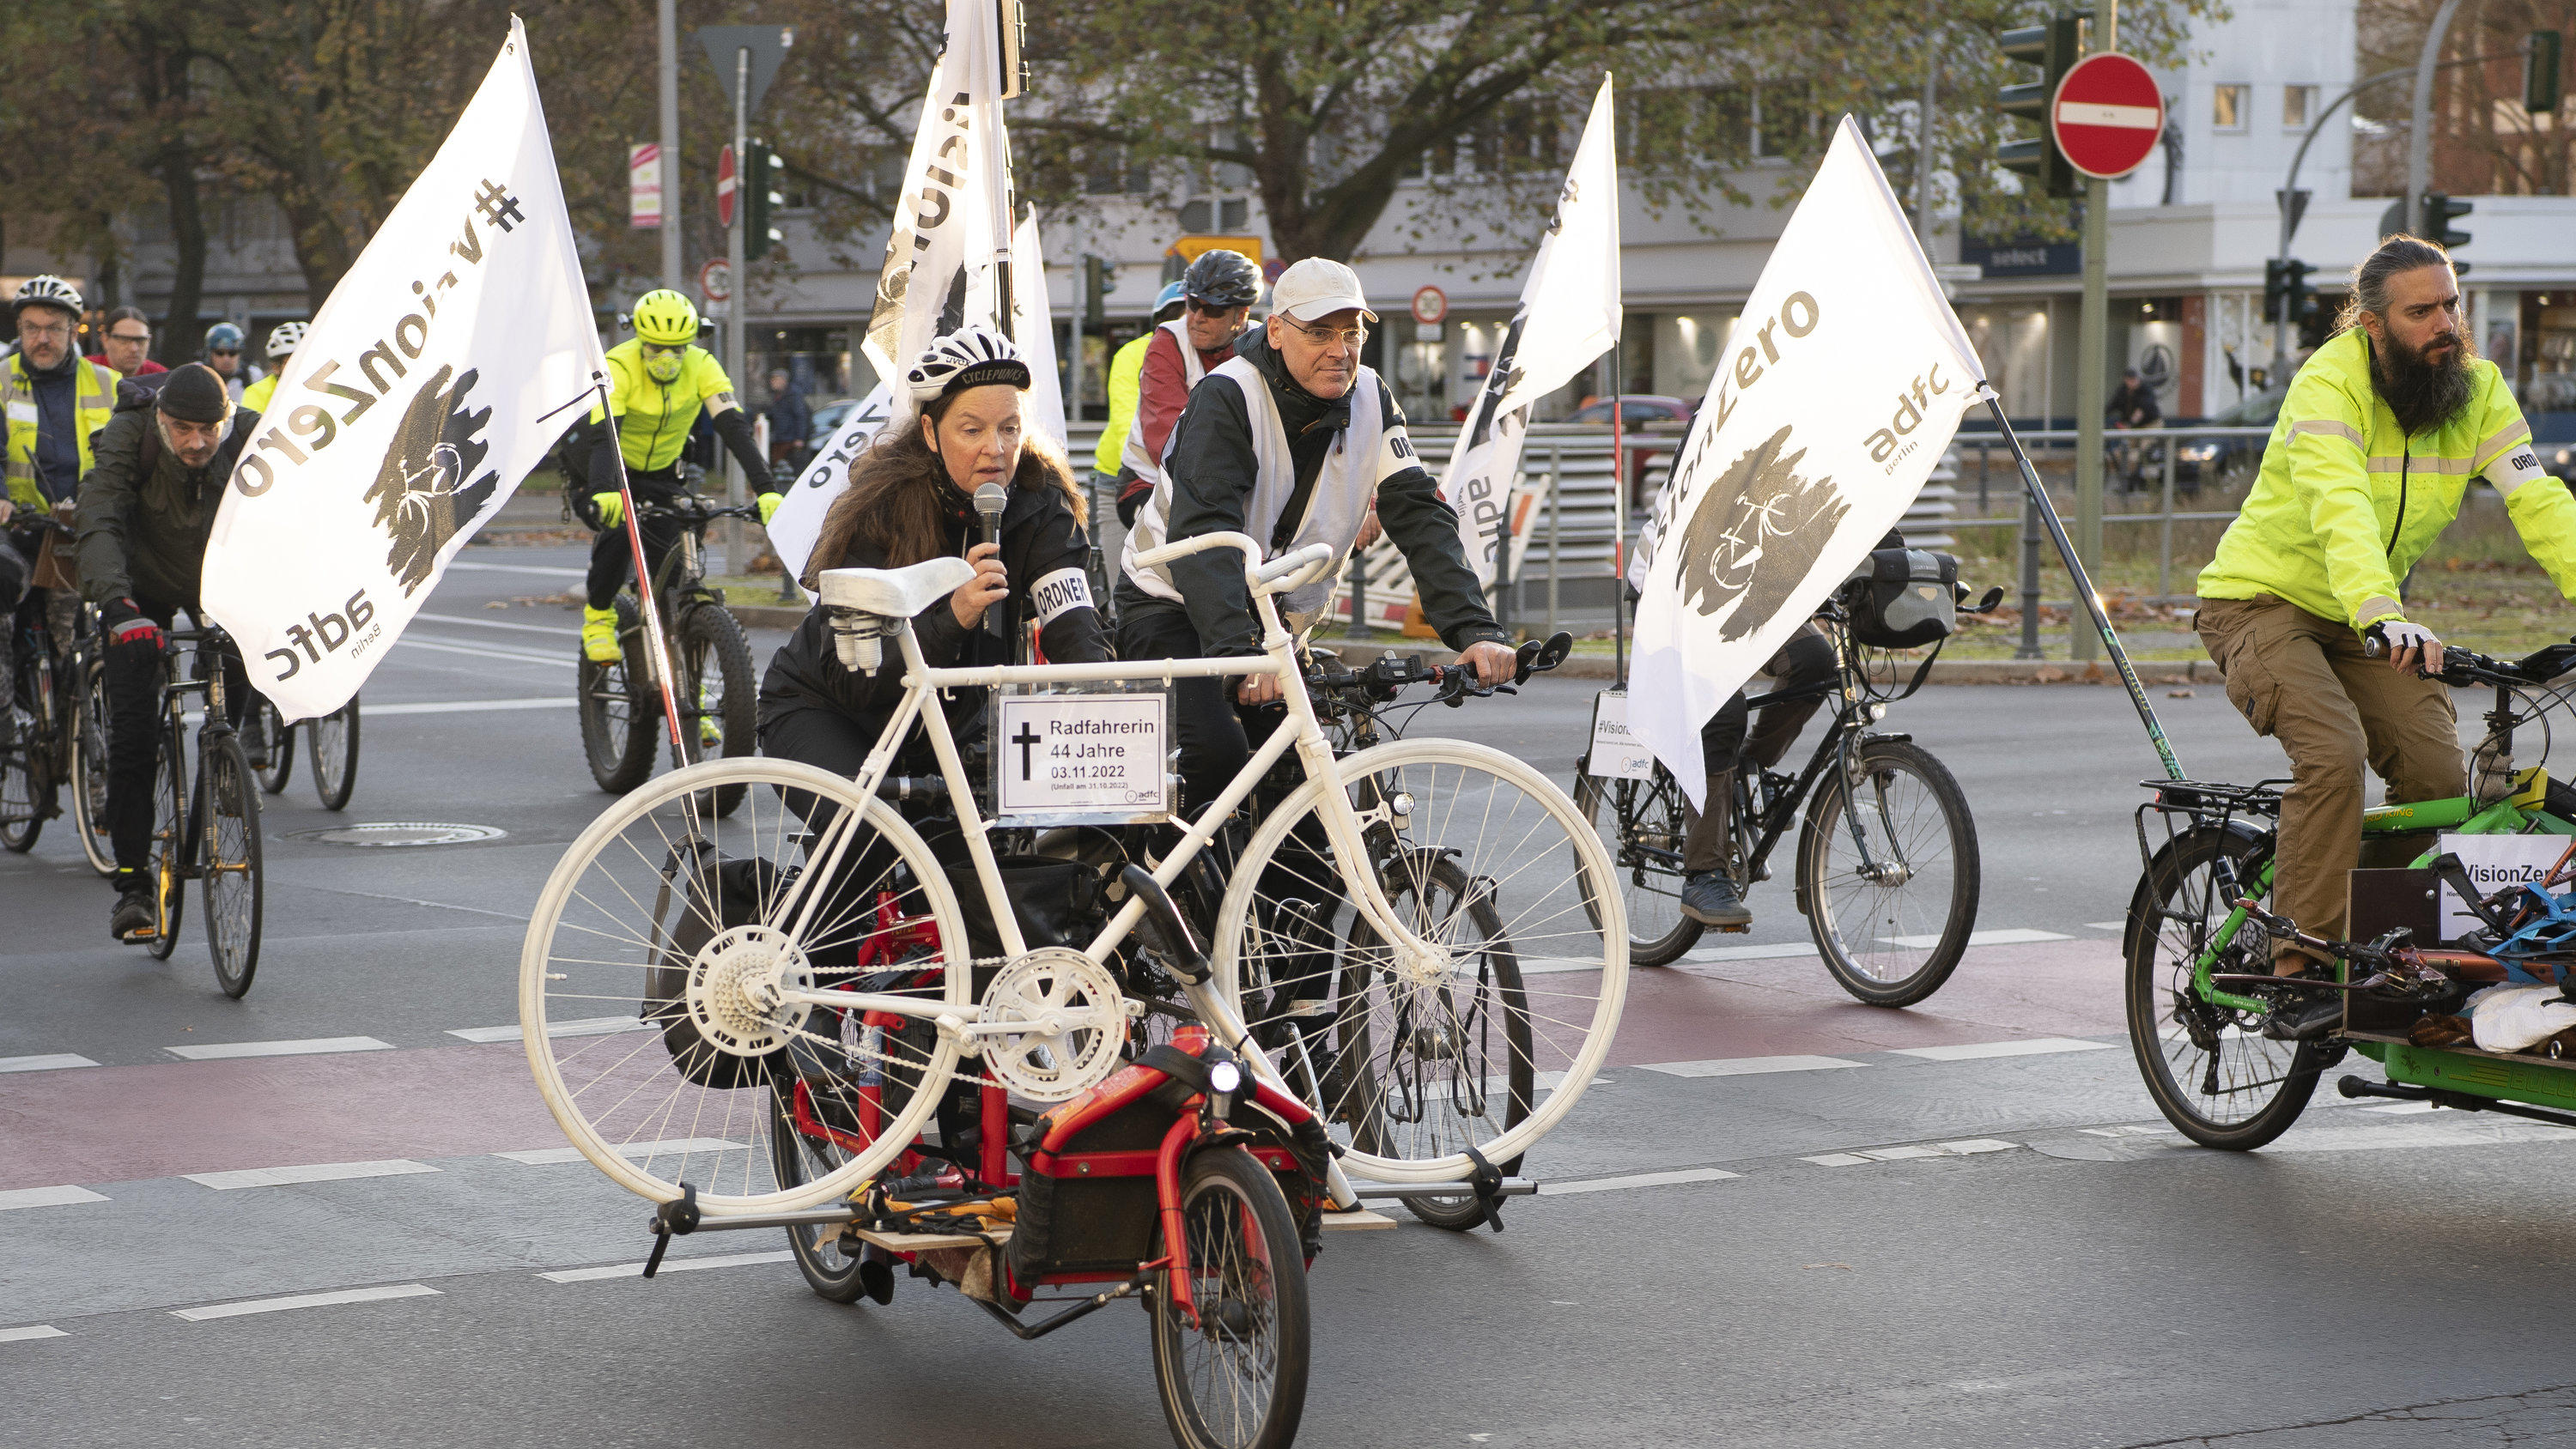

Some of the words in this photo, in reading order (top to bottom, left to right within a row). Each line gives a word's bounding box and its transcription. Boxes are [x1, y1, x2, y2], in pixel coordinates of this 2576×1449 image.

[961, 368, 1025, 385] CYCLEPUNKS
[1863, 361, 1950, 463] adfc
[1885, 440, 1918, 476] Berlin
[1037, 577, 1089, 615] ORDNER
[2119, 657, 2150, 712] FIRSTFISH
[1050, 719, 1154, 735] Radfahrerin
[1050, 743, 1071, 759] 44
[1076, 743, 1125, 759] Jahre
[1631, 758, 1649, 769] adfc
[1051, 765, 1125, 779] 03.11.2022
[1051, 783, 1074, 791] (Unfall
[1139, 790, 1159, 798] adfc
[2386, 808, 2414, 818] KING
